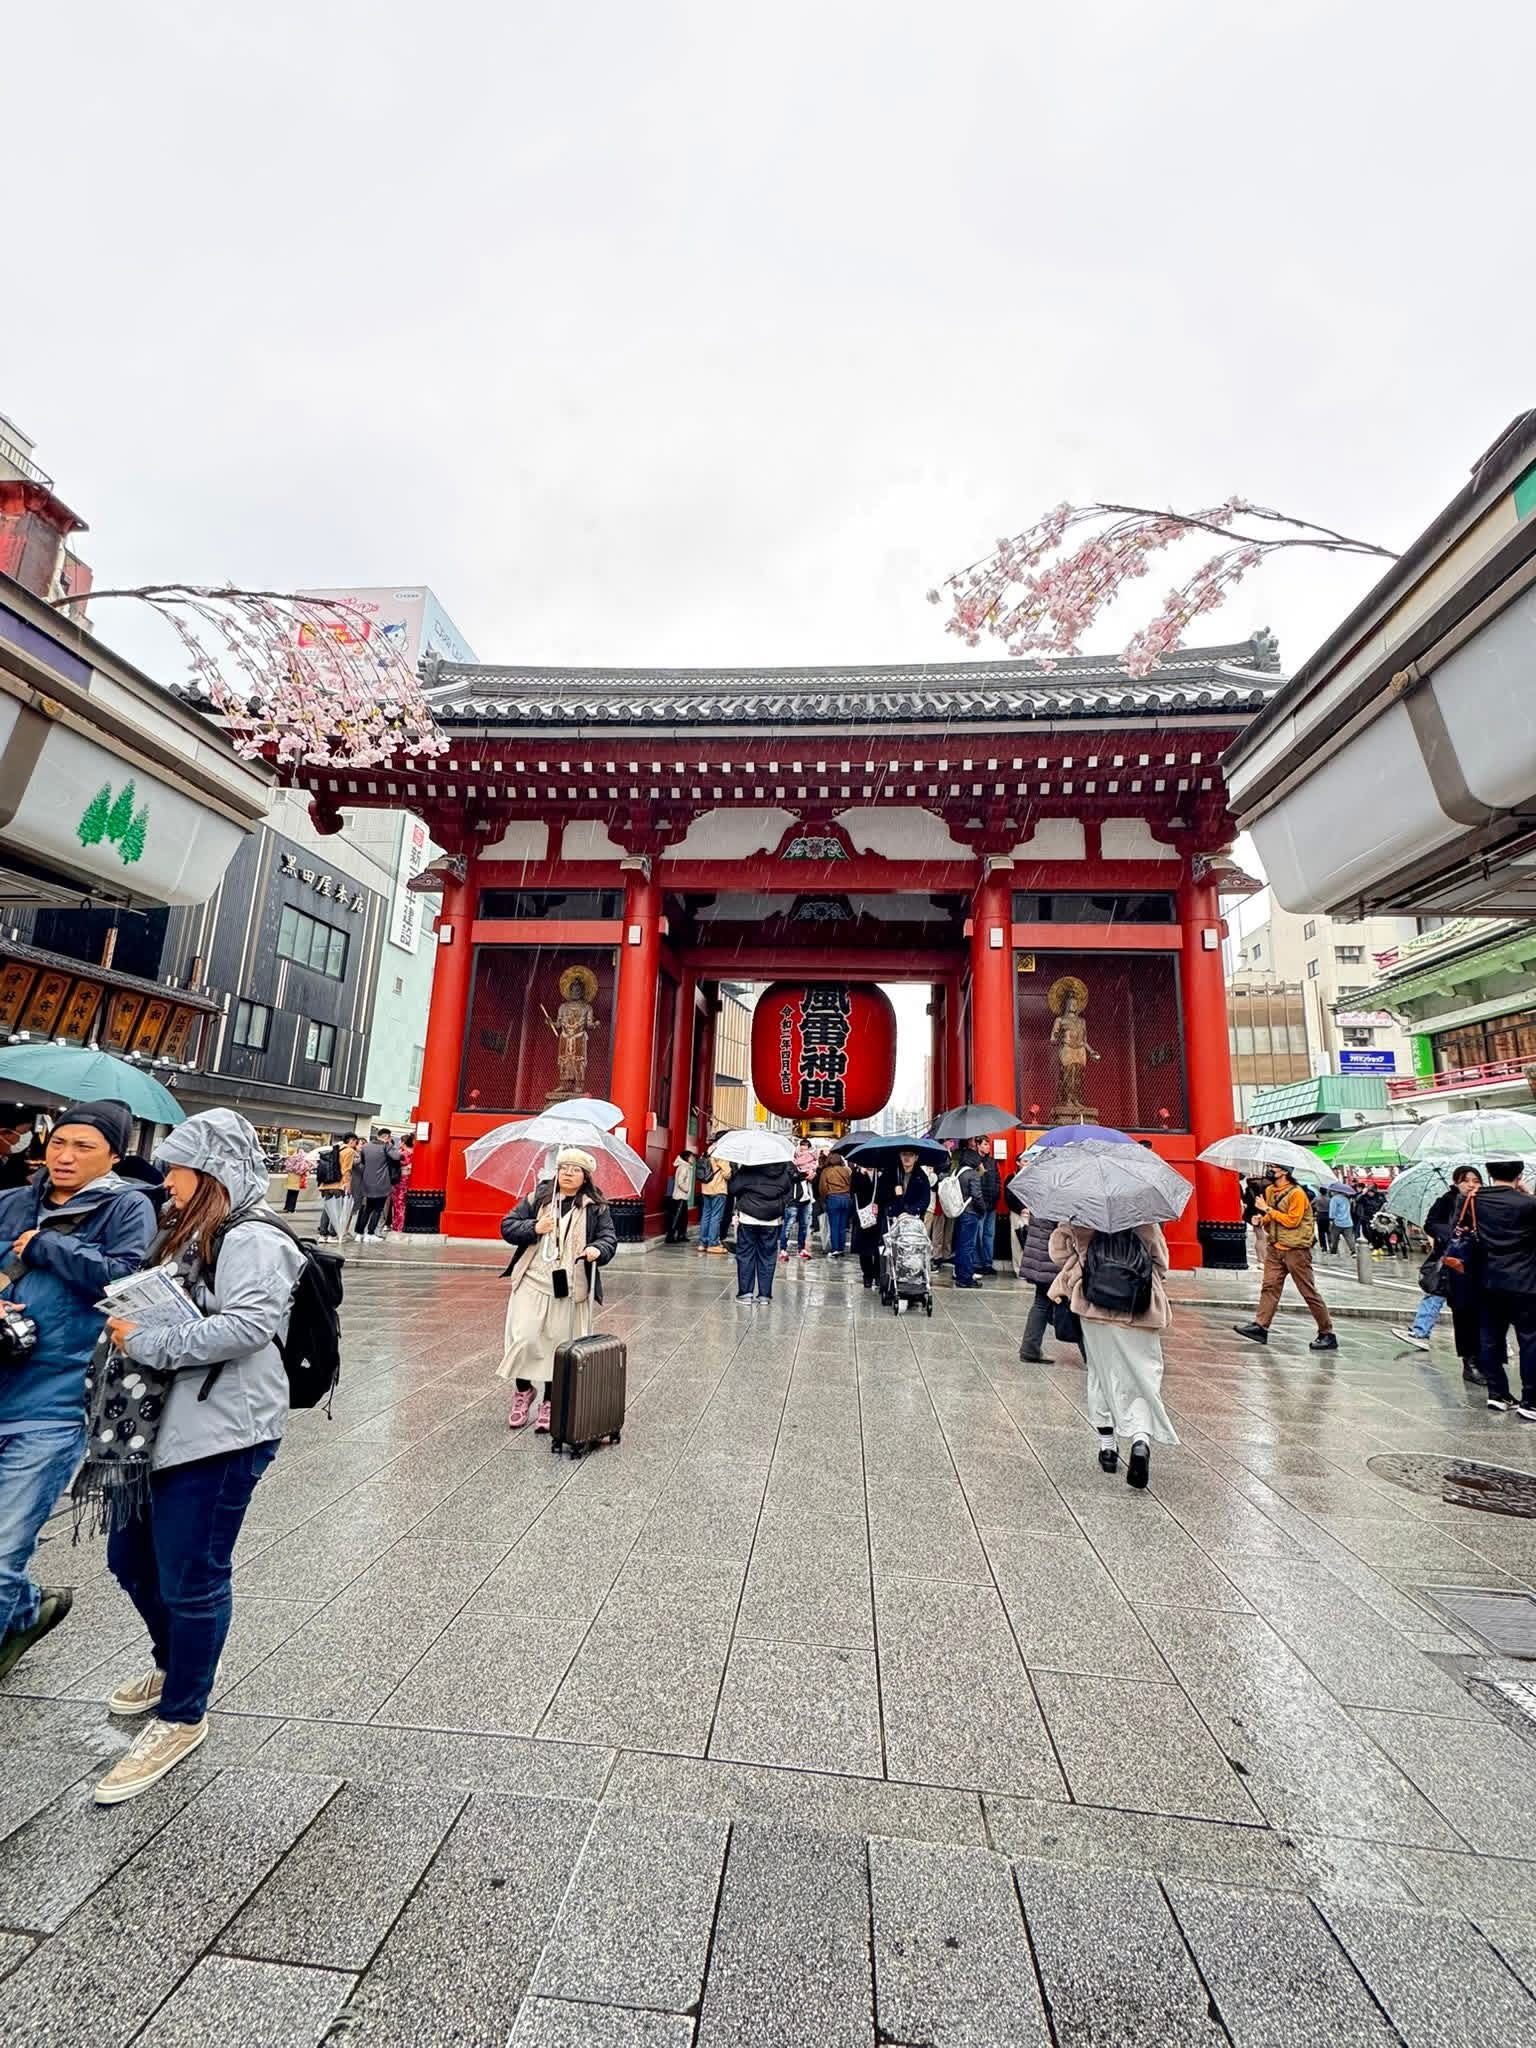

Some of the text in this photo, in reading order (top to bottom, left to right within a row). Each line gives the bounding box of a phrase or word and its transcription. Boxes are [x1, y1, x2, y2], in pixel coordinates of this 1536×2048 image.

[282, 853, 364, 914] 黒田屋本店
[779, 1004, 795, 1095] 令和二年四月吉日
[798, 984, 851, 1113] 風雷神門
